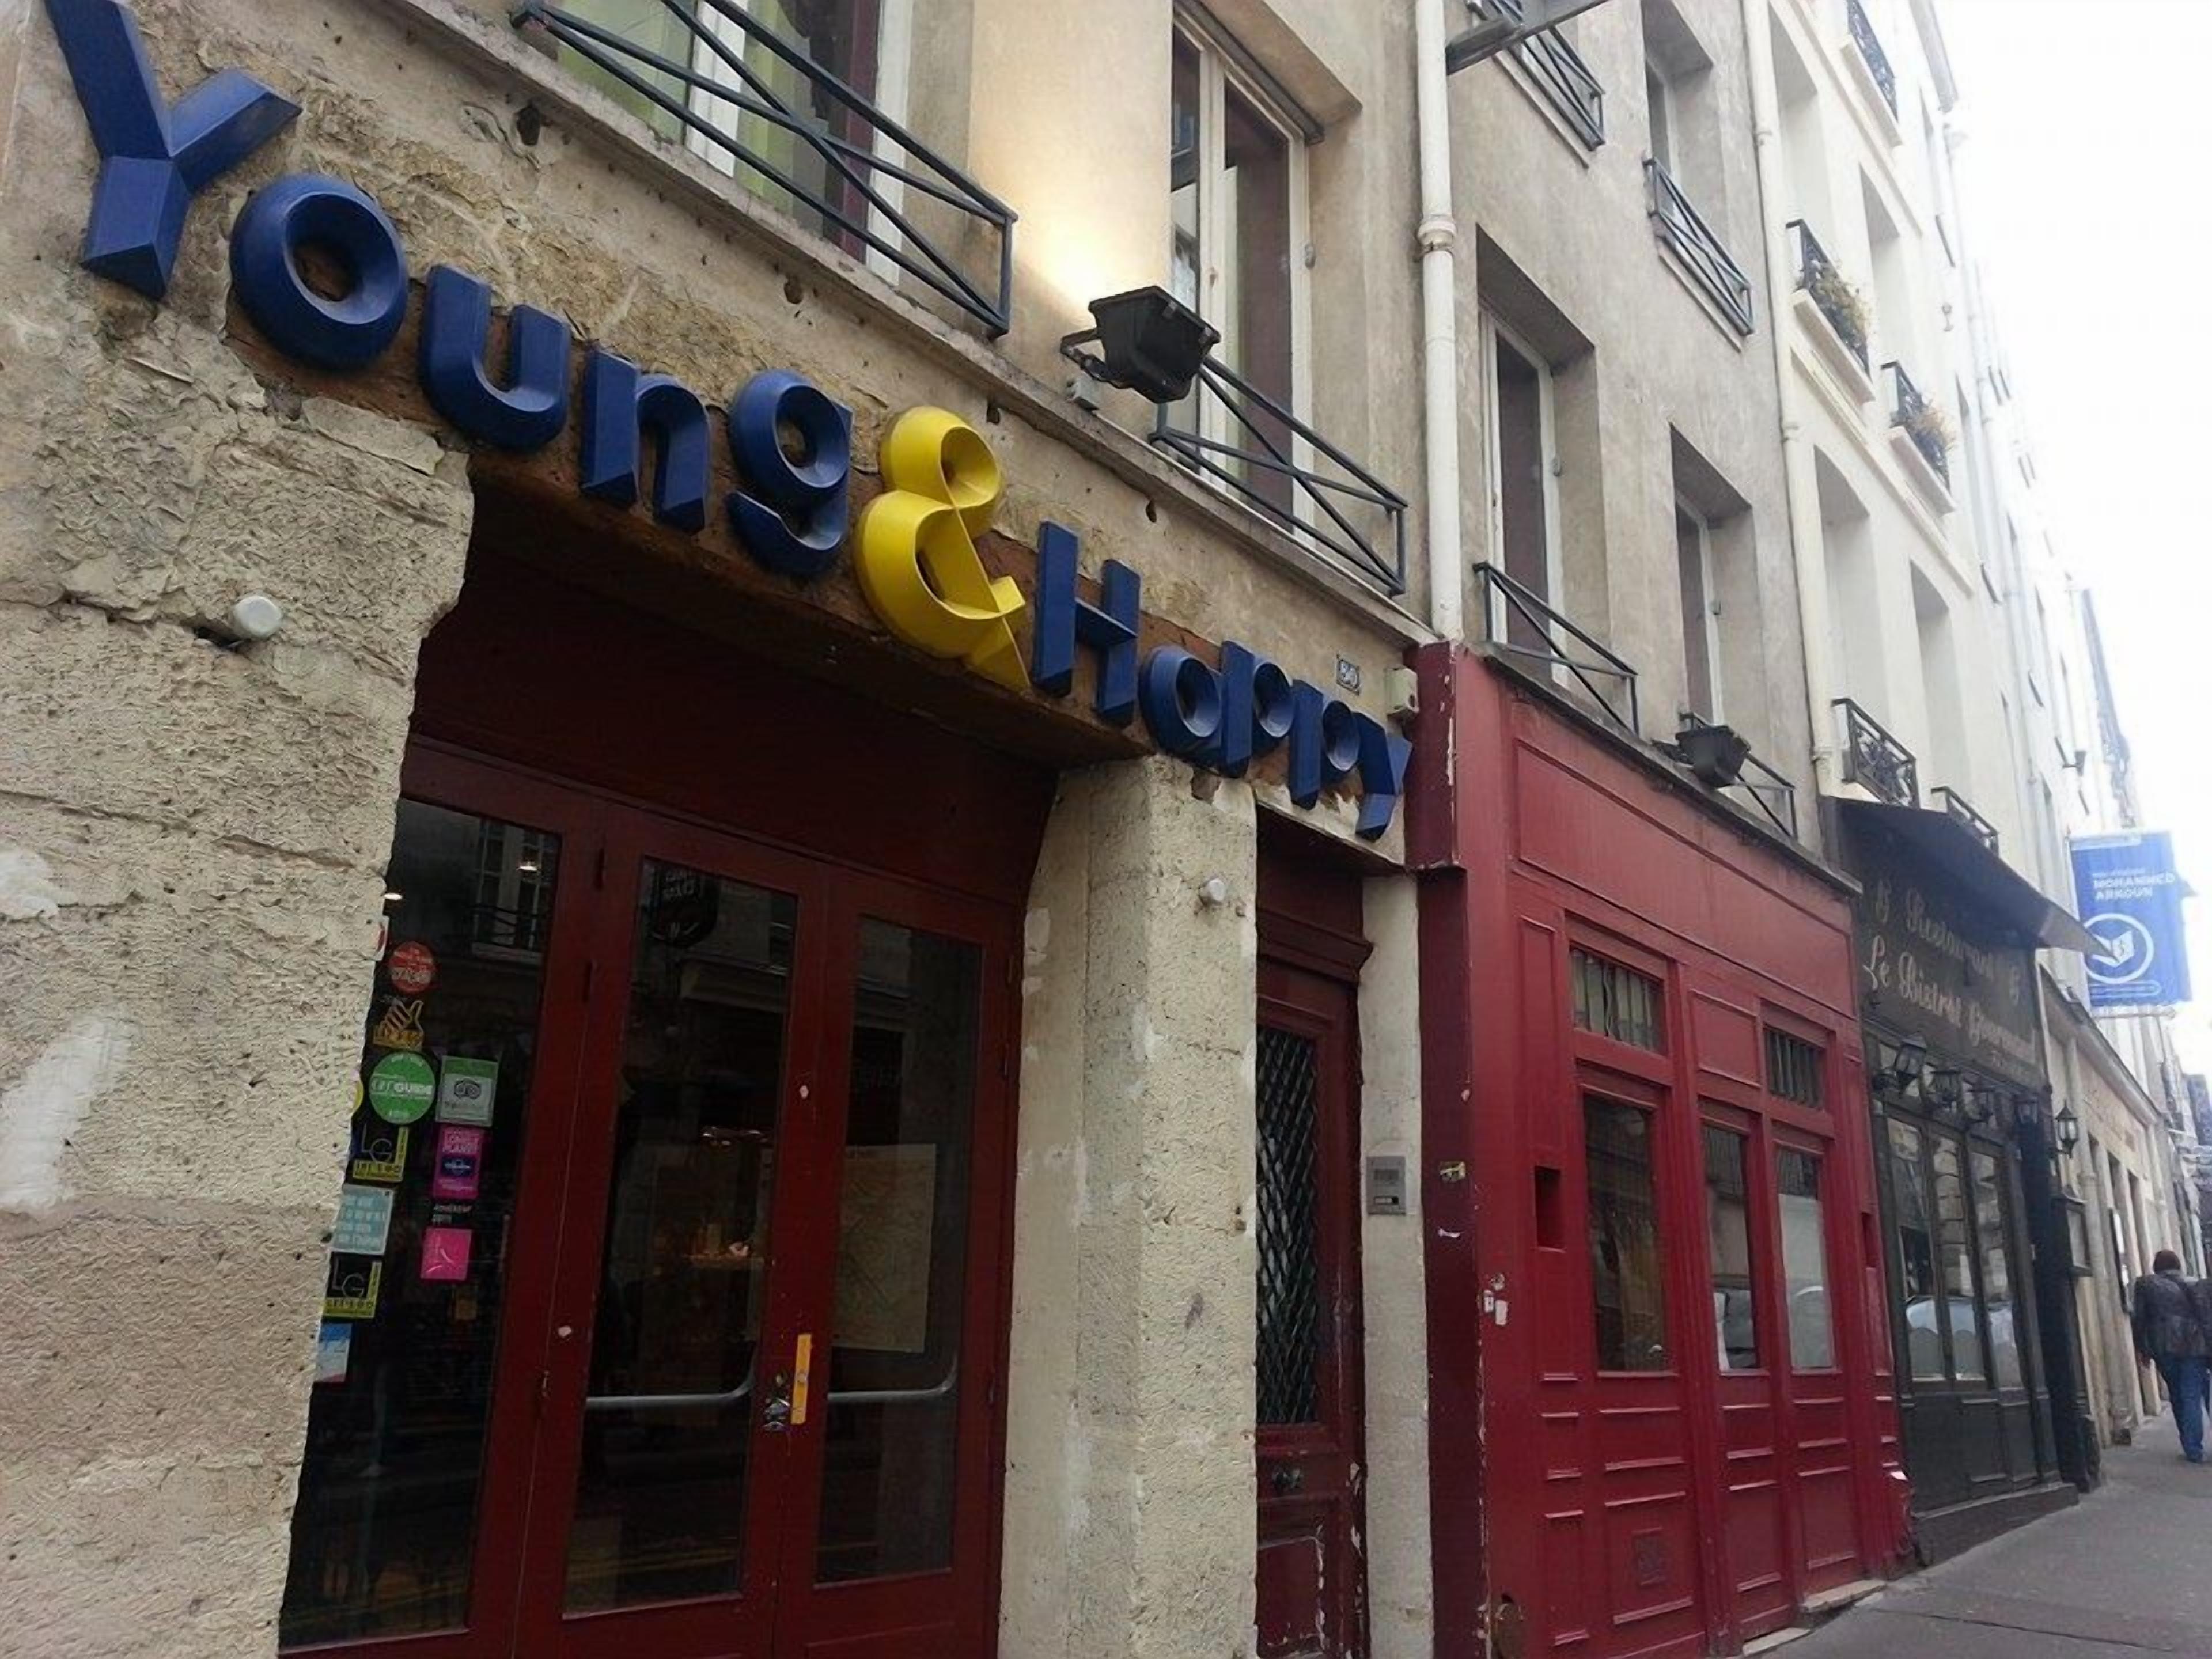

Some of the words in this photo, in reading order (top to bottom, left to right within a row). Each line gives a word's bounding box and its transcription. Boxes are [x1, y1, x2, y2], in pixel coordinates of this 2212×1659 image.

[44, 0, 853, 582] Young
[855, 405, 1031, 690] &
[1032, 521, 1412, 842] Happy
[1862, 935, 1890, 991] Le
